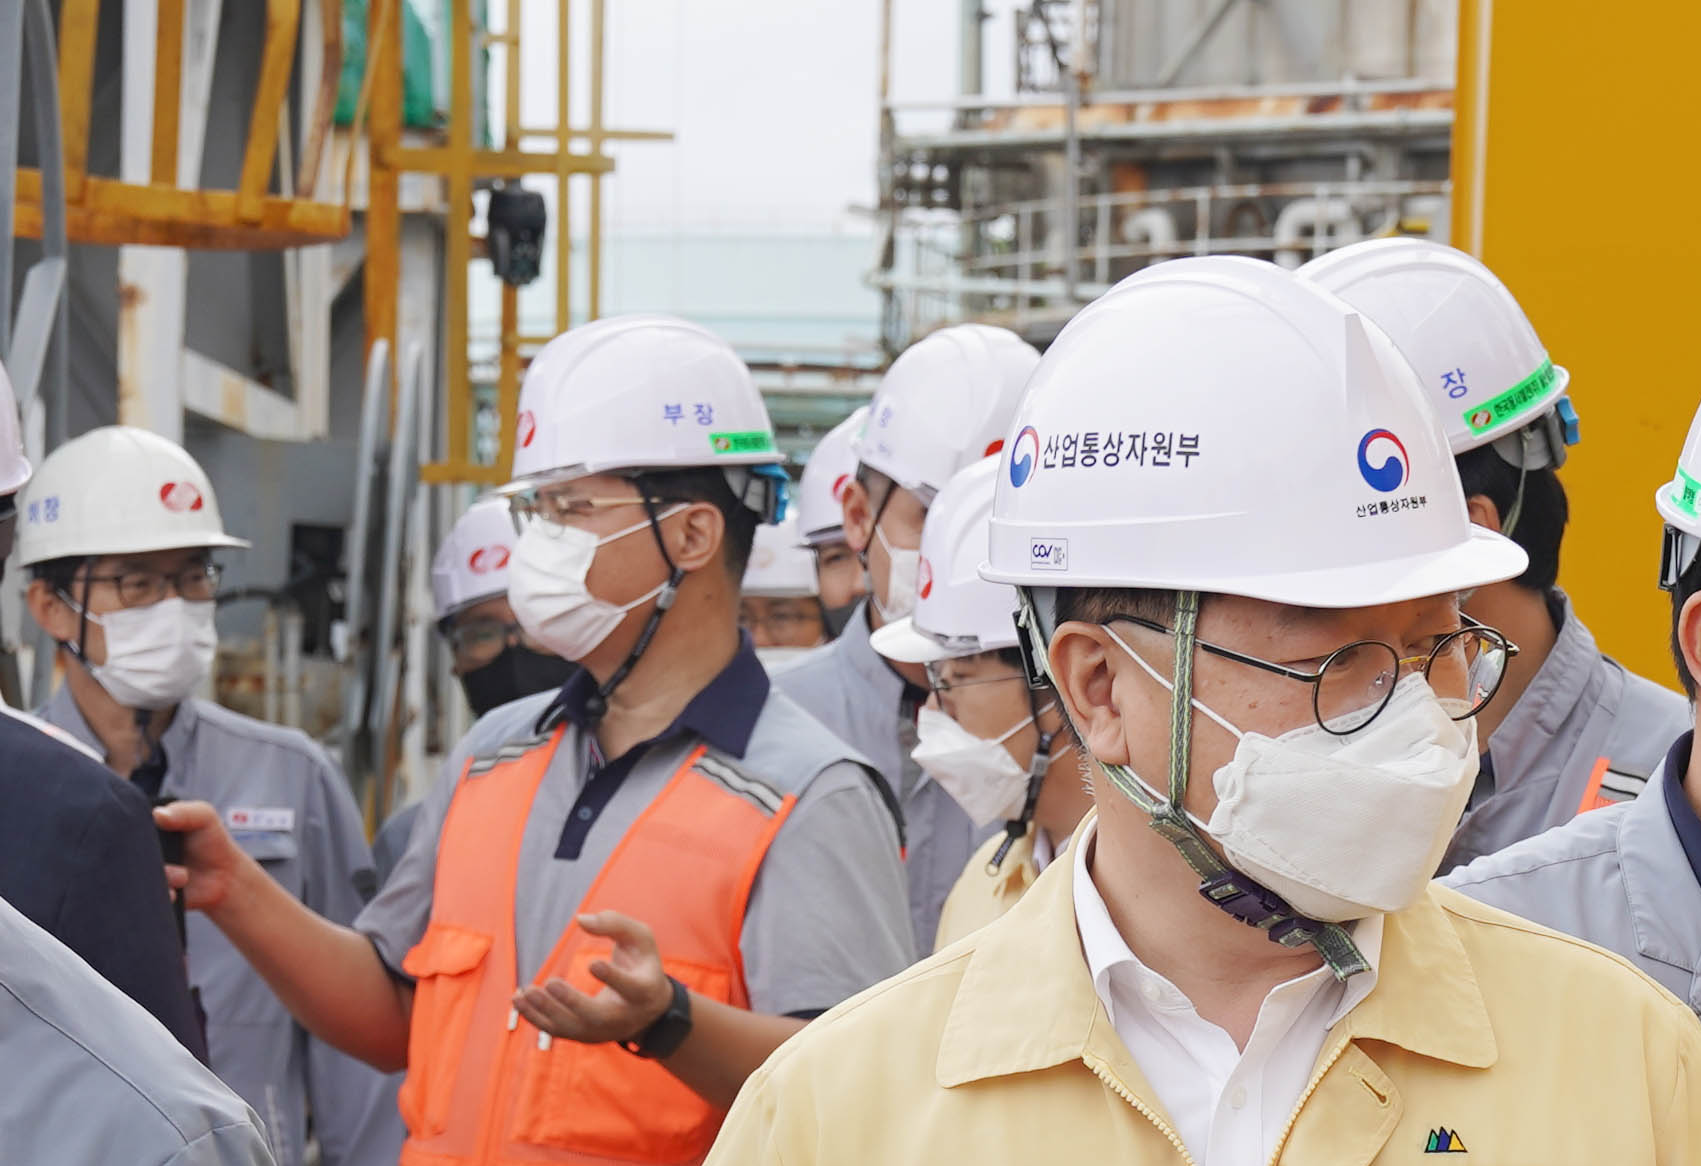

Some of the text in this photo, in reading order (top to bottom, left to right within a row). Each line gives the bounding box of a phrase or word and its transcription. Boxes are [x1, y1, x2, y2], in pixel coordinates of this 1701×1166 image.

[1440, 367, 1468, 399] 장
[1042, 431, 1201, 470] 산업통상자원부
[1354, 494, 1429, 519] 산업통상자원부
